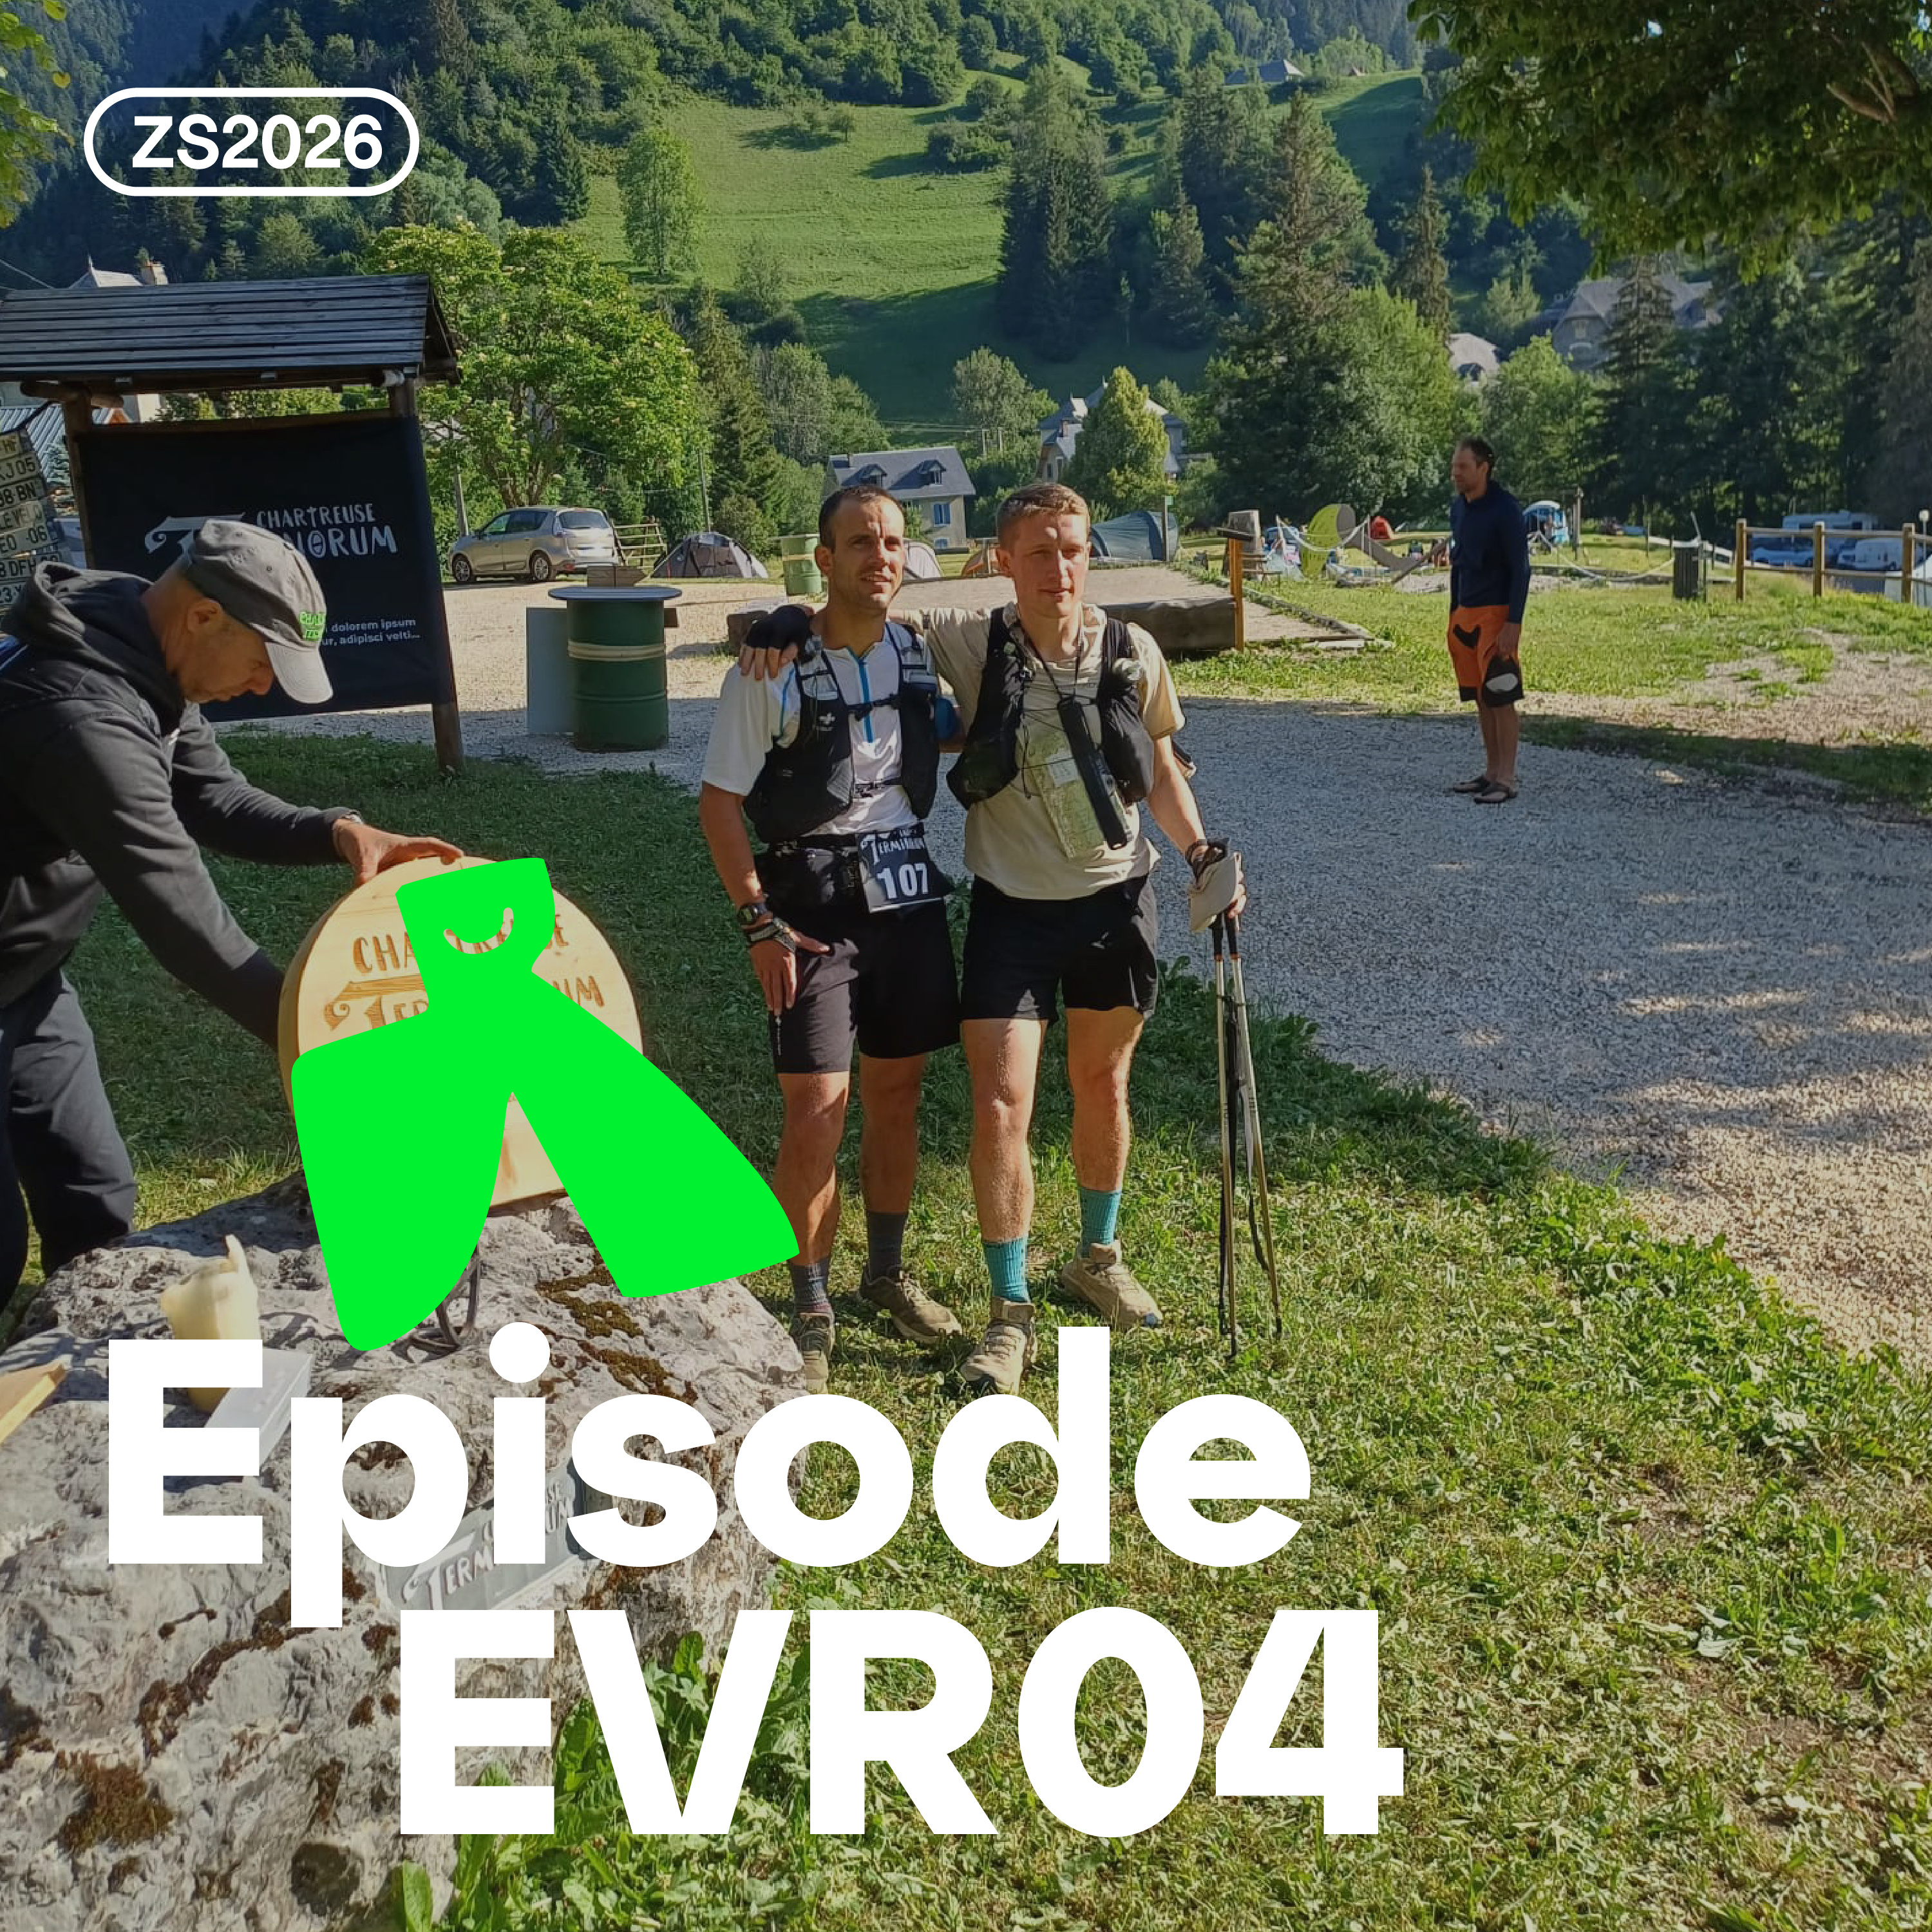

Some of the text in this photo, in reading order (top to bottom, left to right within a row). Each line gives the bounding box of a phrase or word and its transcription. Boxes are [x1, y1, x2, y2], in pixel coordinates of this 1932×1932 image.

[257, 504, 375, 529] CHARTREUSE
[331, 619, 416, 632] dolorem ipsum
[340, 632, 383, 645] adipisci
[877, 863, 929, 900] 107
